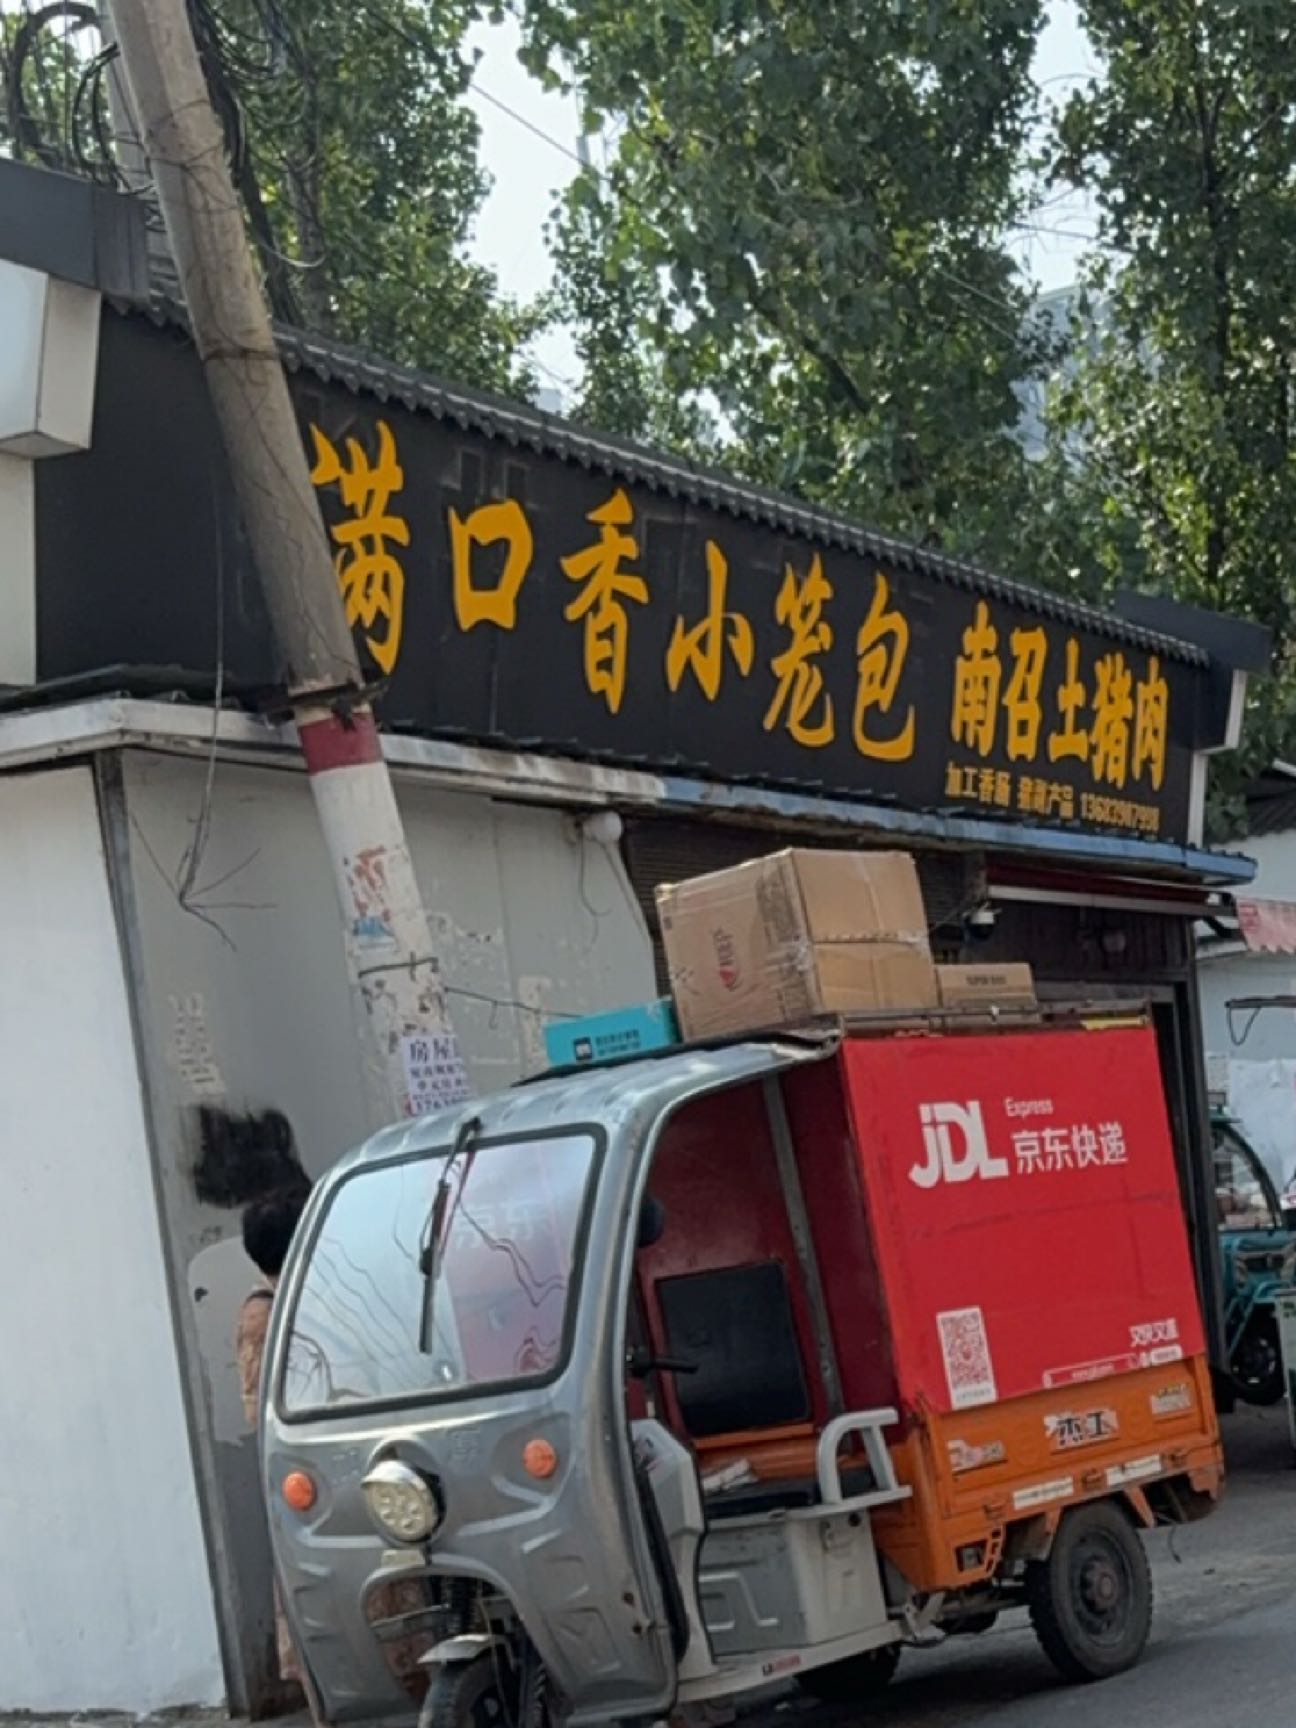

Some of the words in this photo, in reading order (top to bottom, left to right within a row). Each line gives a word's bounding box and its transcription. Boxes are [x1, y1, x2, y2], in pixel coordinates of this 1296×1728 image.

[950, 600, 1171, 791] 南召土猪肉
[1004, 1096, 1054, 1118] Express
[908, 1100, 1009, 1189] JDL
[1010, 1121, 1129, 1175] 京东快递
